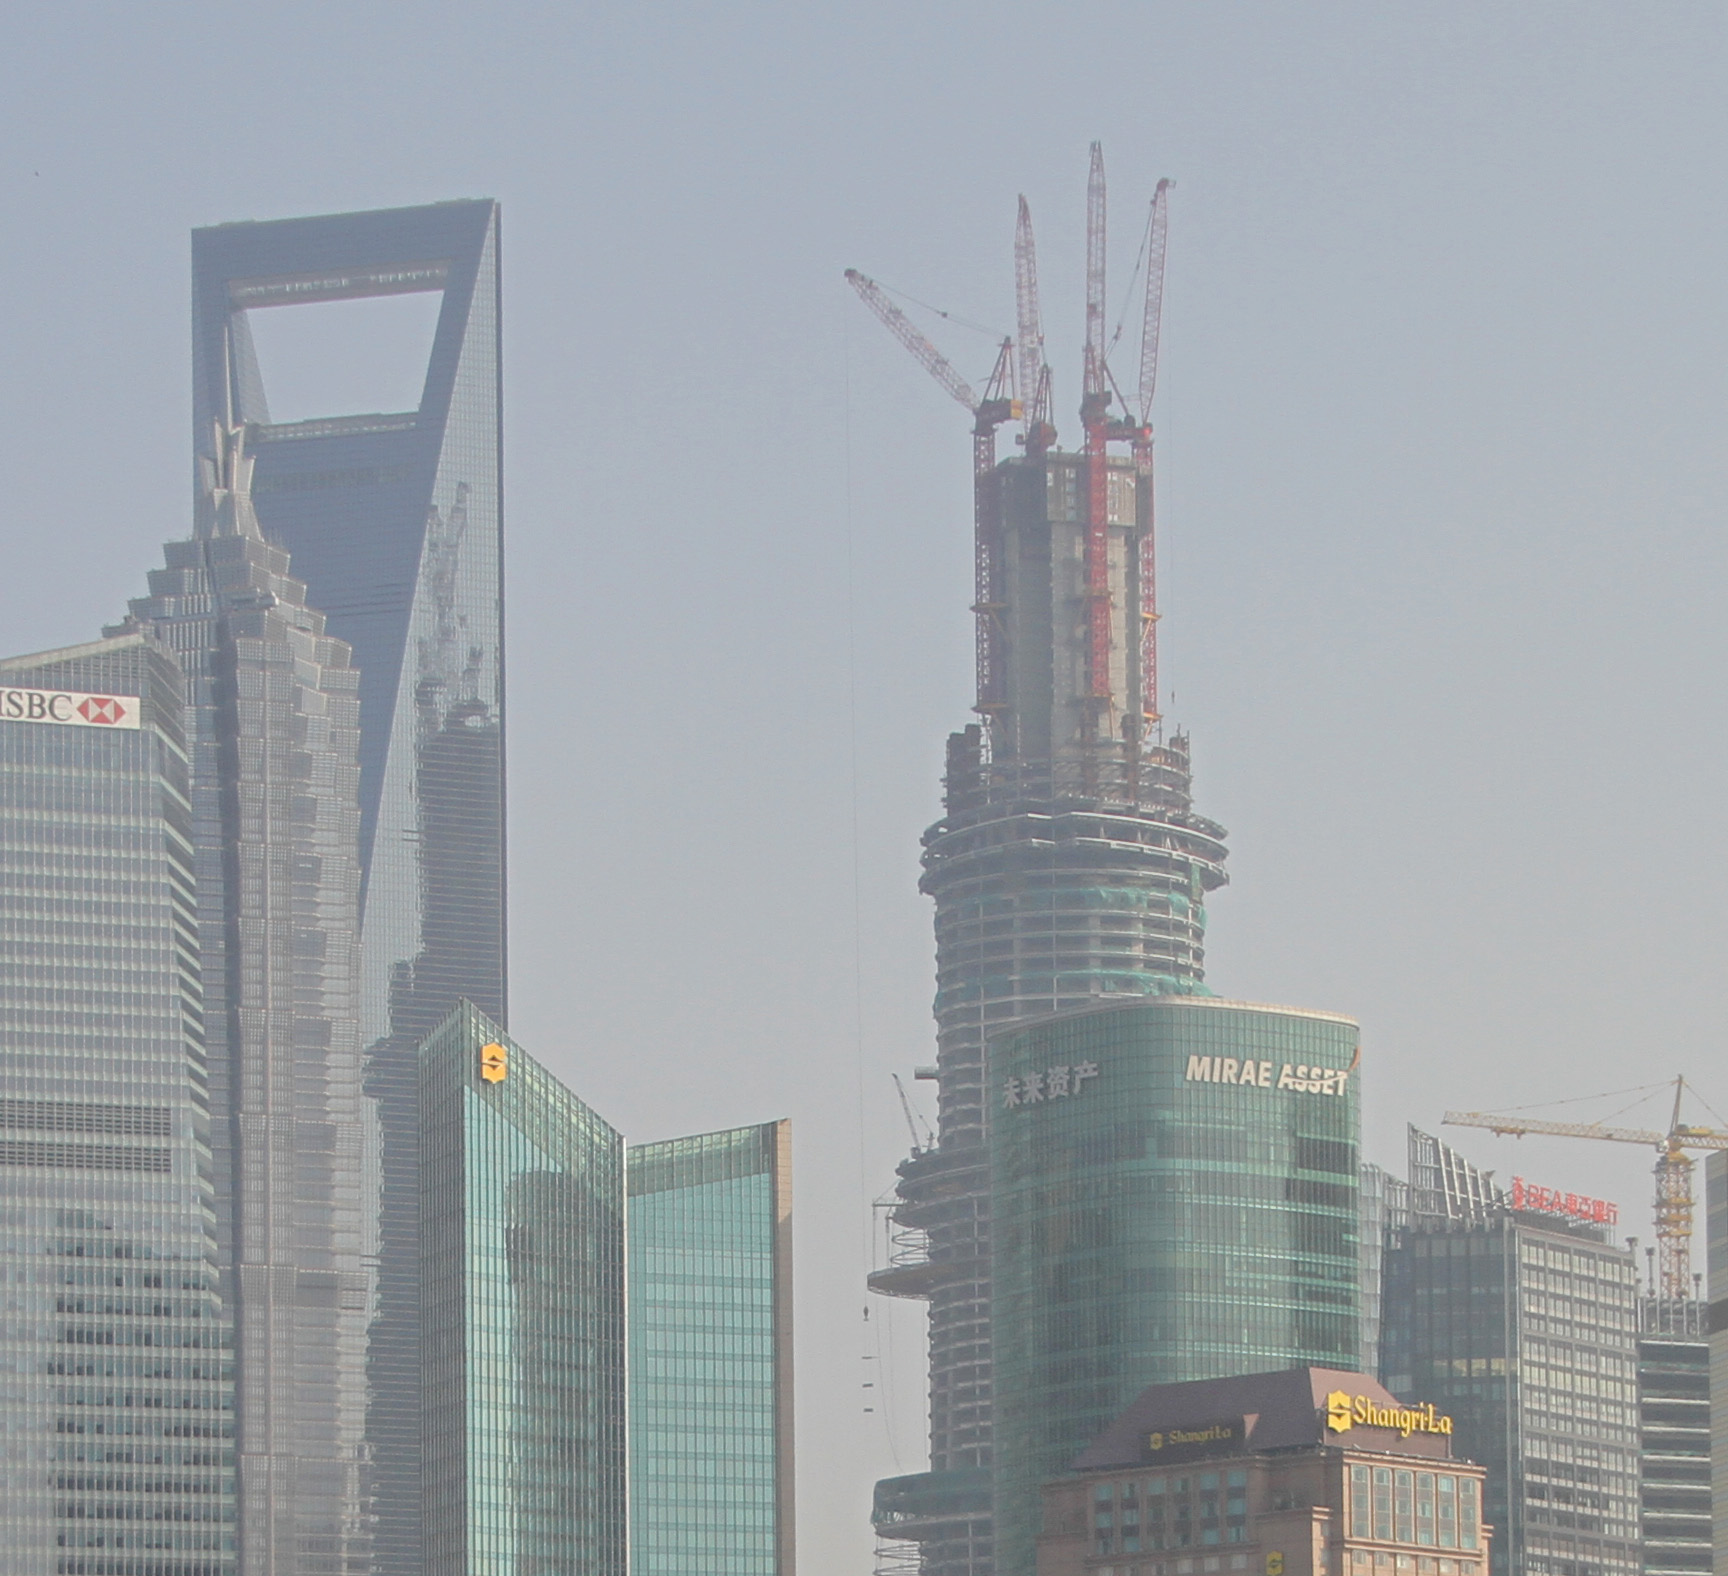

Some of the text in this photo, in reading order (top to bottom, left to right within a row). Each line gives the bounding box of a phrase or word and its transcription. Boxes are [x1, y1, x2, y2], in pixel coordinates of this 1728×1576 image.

[1002, 1060, 1099, 1109] 未来资产
[1186, 1054, 1349, 1097] MIRAE ASSET
[1527, 1184, 1566, 1214] BEA
